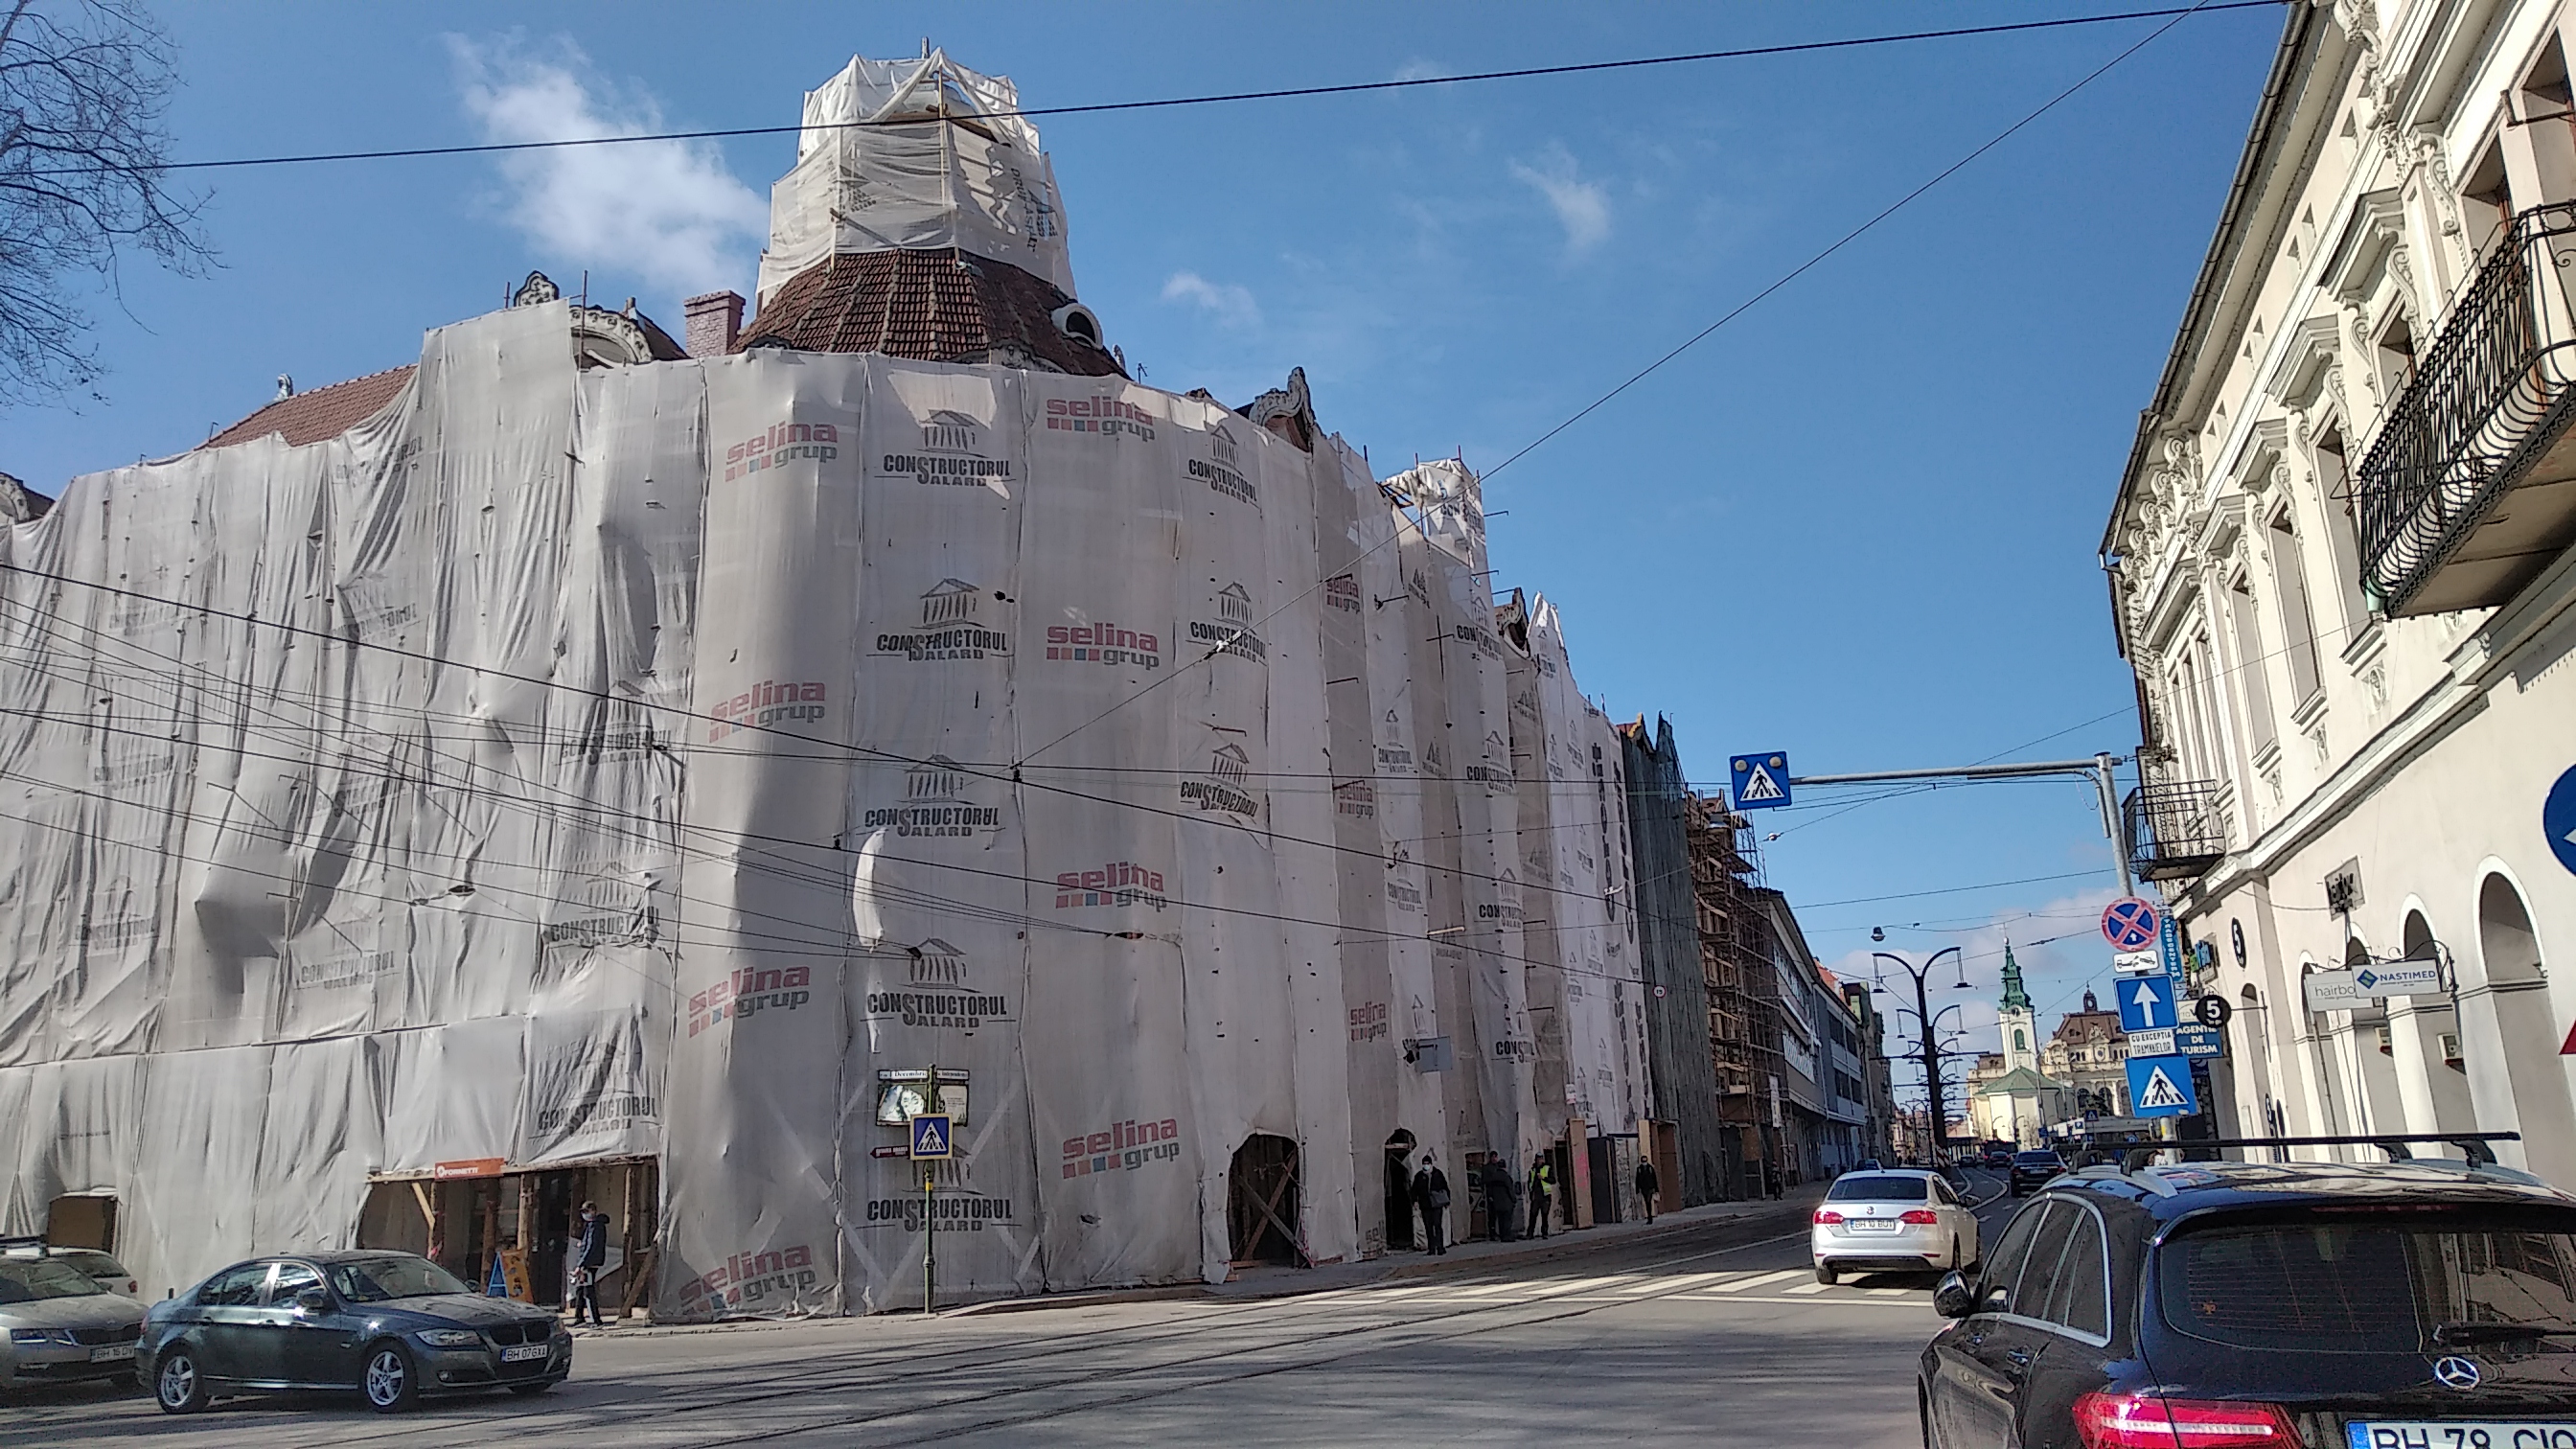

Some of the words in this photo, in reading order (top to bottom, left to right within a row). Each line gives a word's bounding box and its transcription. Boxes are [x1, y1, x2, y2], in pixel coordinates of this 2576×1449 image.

[1046, 396, 1154, 426] selina
[725, 421, 839, 466] selina
[1101, 419, 1155, 442] grup
[773, 444, 838, 469] grup
[883, 454, 1011, 480] CONSTRUCTORUL
[1188, 458, 1257, 502] CONSTRUCTORUL
[1046, 622, 1159, 653] selina
[1102, 649, 1160, 671] grup
[708, 679, 826, 724] selina
[758, 704, 826, 726] grup
[864, 807, 999, 833] CONSTRUCTORUL
[1057, 861, 1164, 893] selina
[1115, 886, 1167, 912] grup
[2380, 970, 2436, 981] NASTIMED
[688, 965, 811, 1019] selina
[736, 989, 811, 1019] grup
[866, 992, 1008, 1022] CONSTRUCTORUL
[2206, 1000, 2220, 1019] 5
[2141, 1032, 2172, 1041] EXCEPTIA
[2180, 1045, 2218, 1054] TURISM
[2191, 1035, 2204, 1044] DE
[1062, 1117, 1179, 1161] selina
[1124, 1141, 1181, 1171] grup
[678, 1245, 813, 1308] selina
[743, 1268, 816, 1302] grup
[506, 1348, 520, 1360] BH
